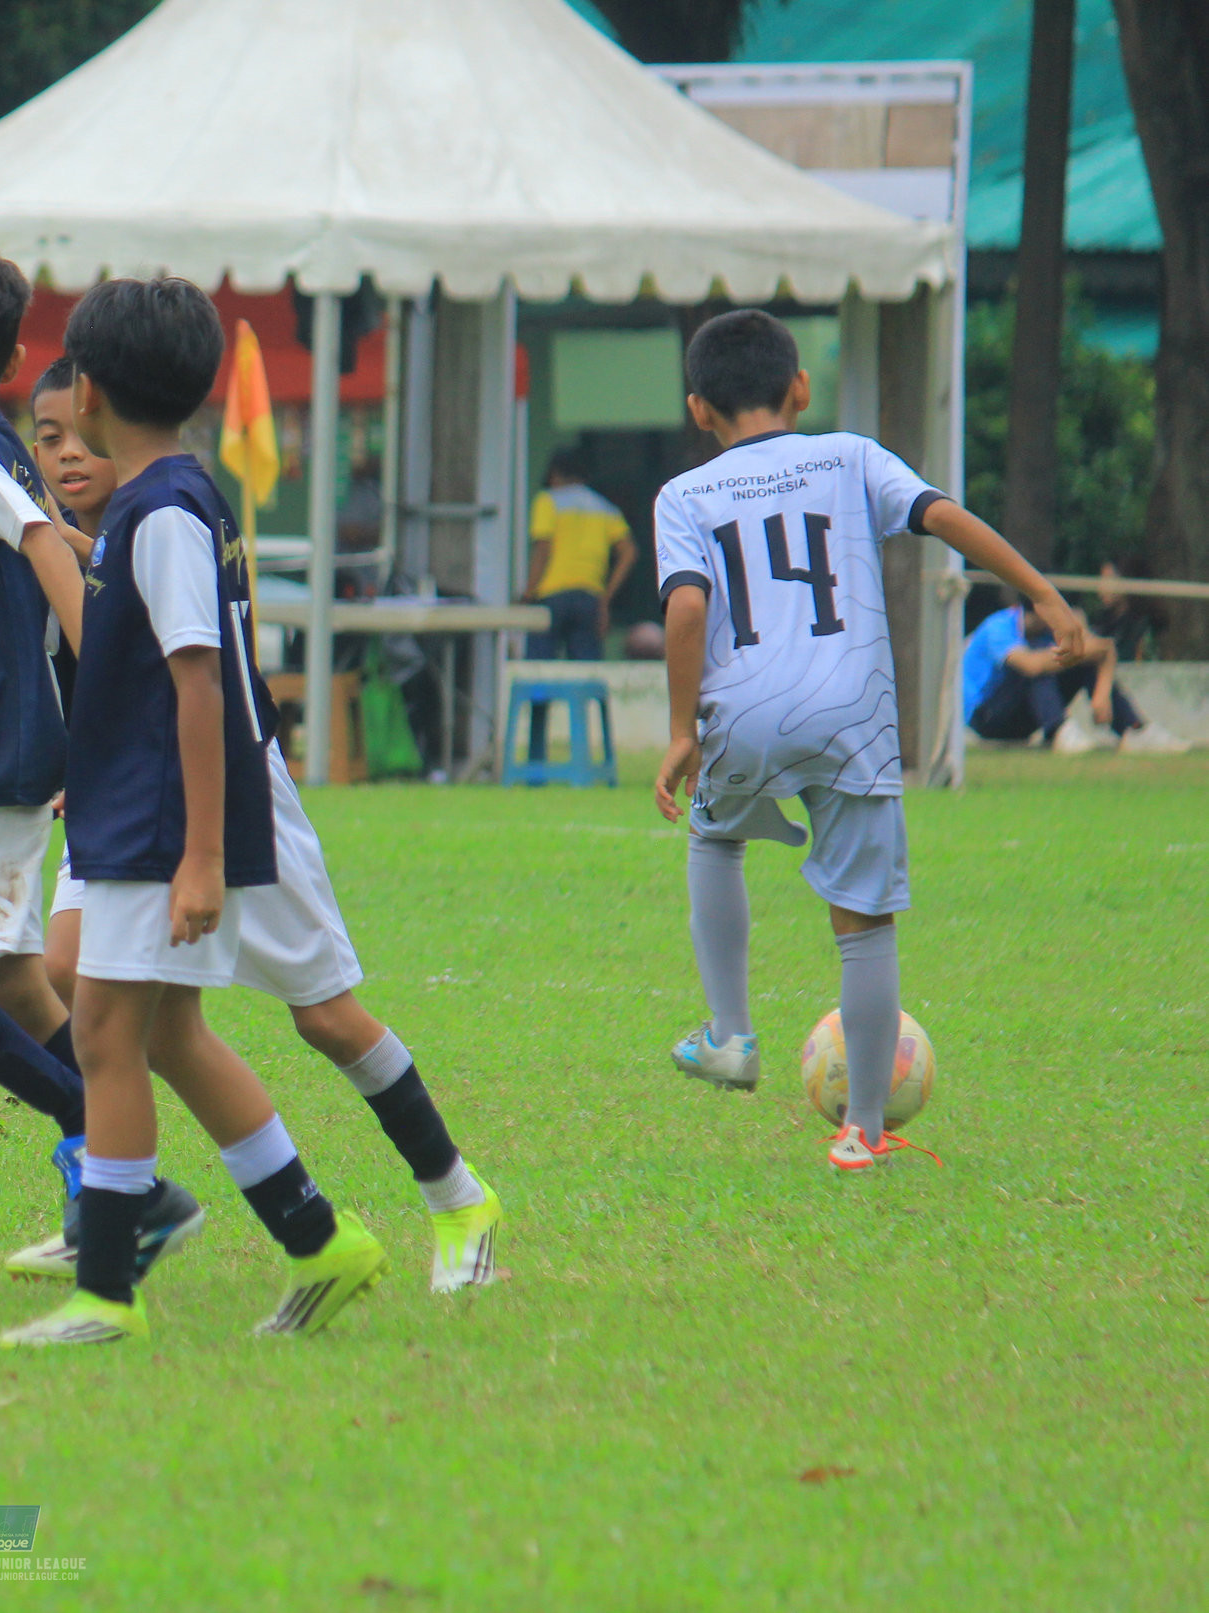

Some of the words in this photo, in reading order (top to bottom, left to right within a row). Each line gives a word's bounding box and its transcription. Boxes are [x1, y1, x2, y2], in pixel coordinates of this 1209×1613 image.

[682, 482, 715, 497] ASIA
[718, 468, 793, 490] FOOTBALL
[732, 477, 809, 501] INDONESIA
[713, 511, 845, 650] 14
